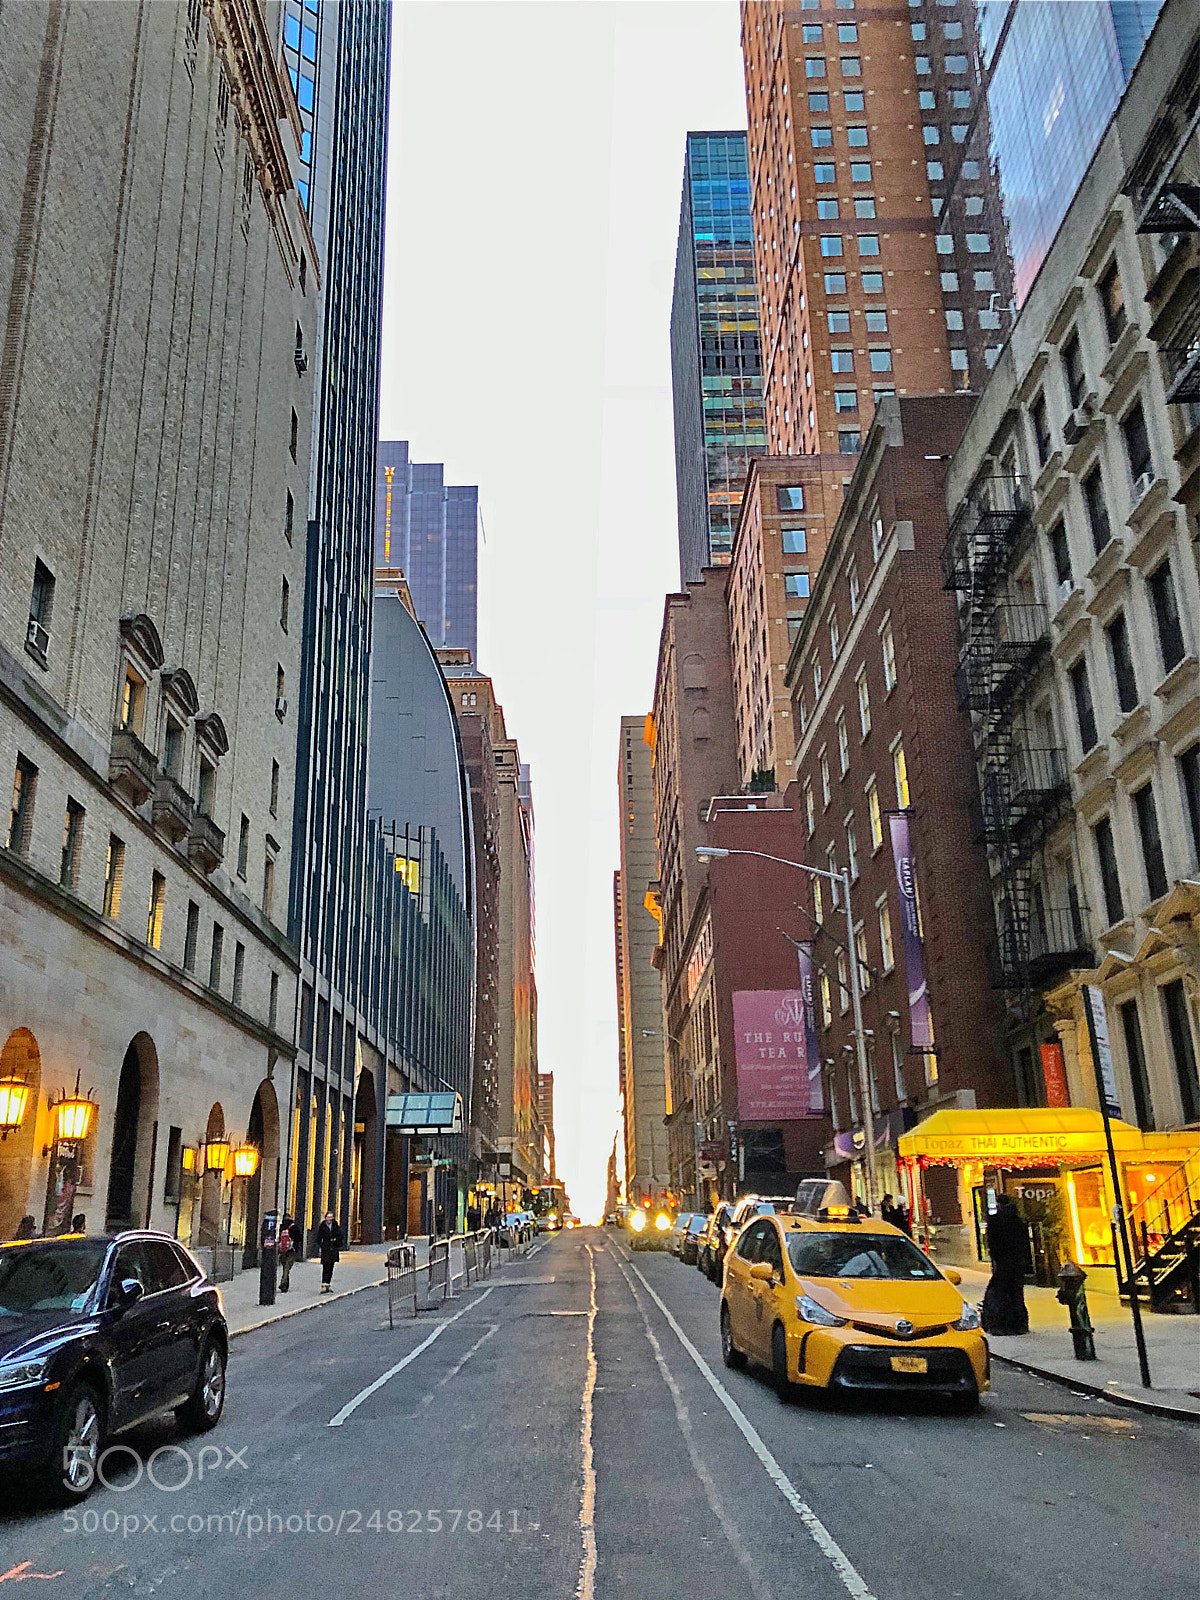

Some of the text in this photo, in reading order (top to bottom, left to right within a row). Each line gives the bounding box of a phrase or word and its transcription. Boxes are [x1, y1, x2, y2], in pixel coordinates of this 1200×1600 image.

[902, 857, 913, 894] KAPLAN
[744, 1032, 802, 1044] THE RU
[759, 1047, 806, 1058] TEA R
[922, 1136, 963, 1152] Topaz
[970, 1137, 997, 1148] THAI
[1001, 1136, 1067, 1149] AUTHENTIC
[1014, 1186, 1057, 1202] Topa
[268, 1221, 274, 1230] P
